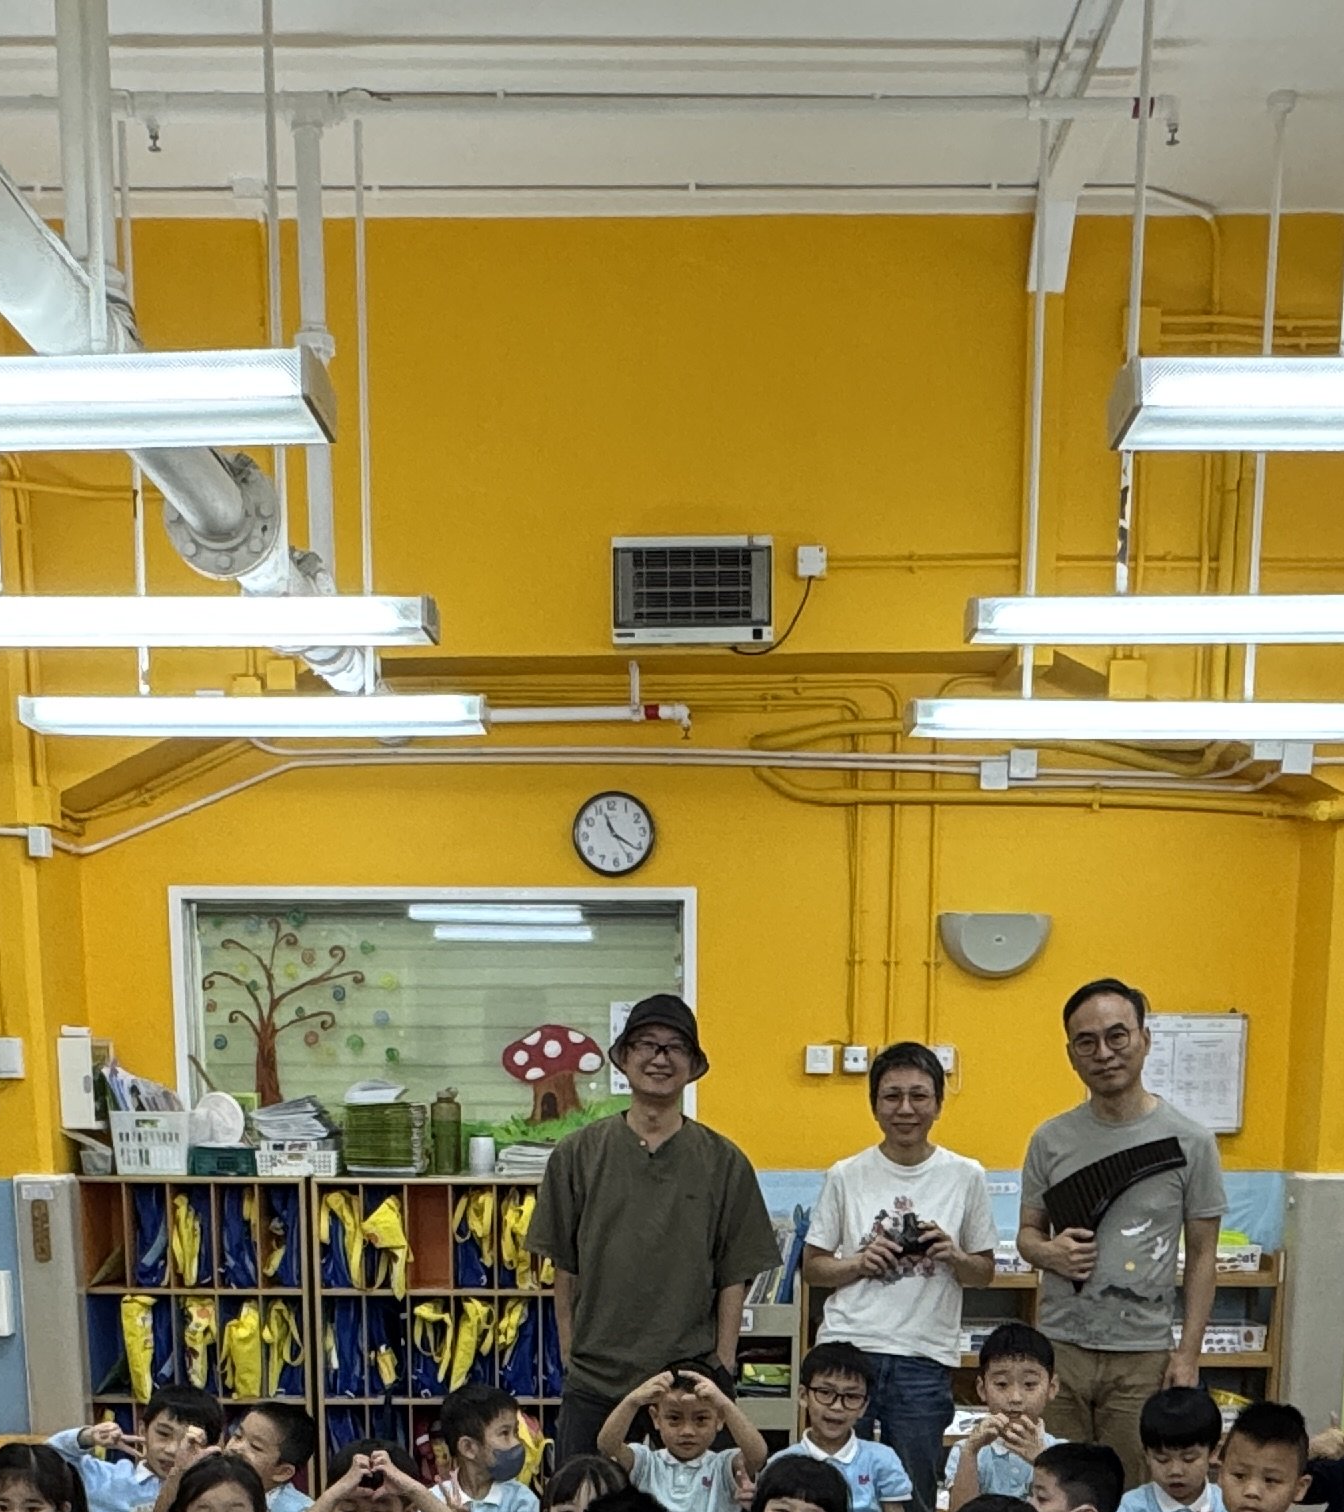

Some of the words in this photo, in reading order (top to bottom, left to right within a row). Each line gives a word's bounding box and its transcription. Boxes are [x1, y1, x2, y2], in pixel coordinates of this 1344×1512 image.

[594, 804, 603, 816] 11
[606, 800, 617, 811] 12
[584, 816, 595, 827] 10
[633, 812, 641, 824] 2
[581, 831, 590, 842] 9
[638, 826, 647, 837] 3
[598, 854, 606, 865] 7
[612, 857, 621, 868] 6
